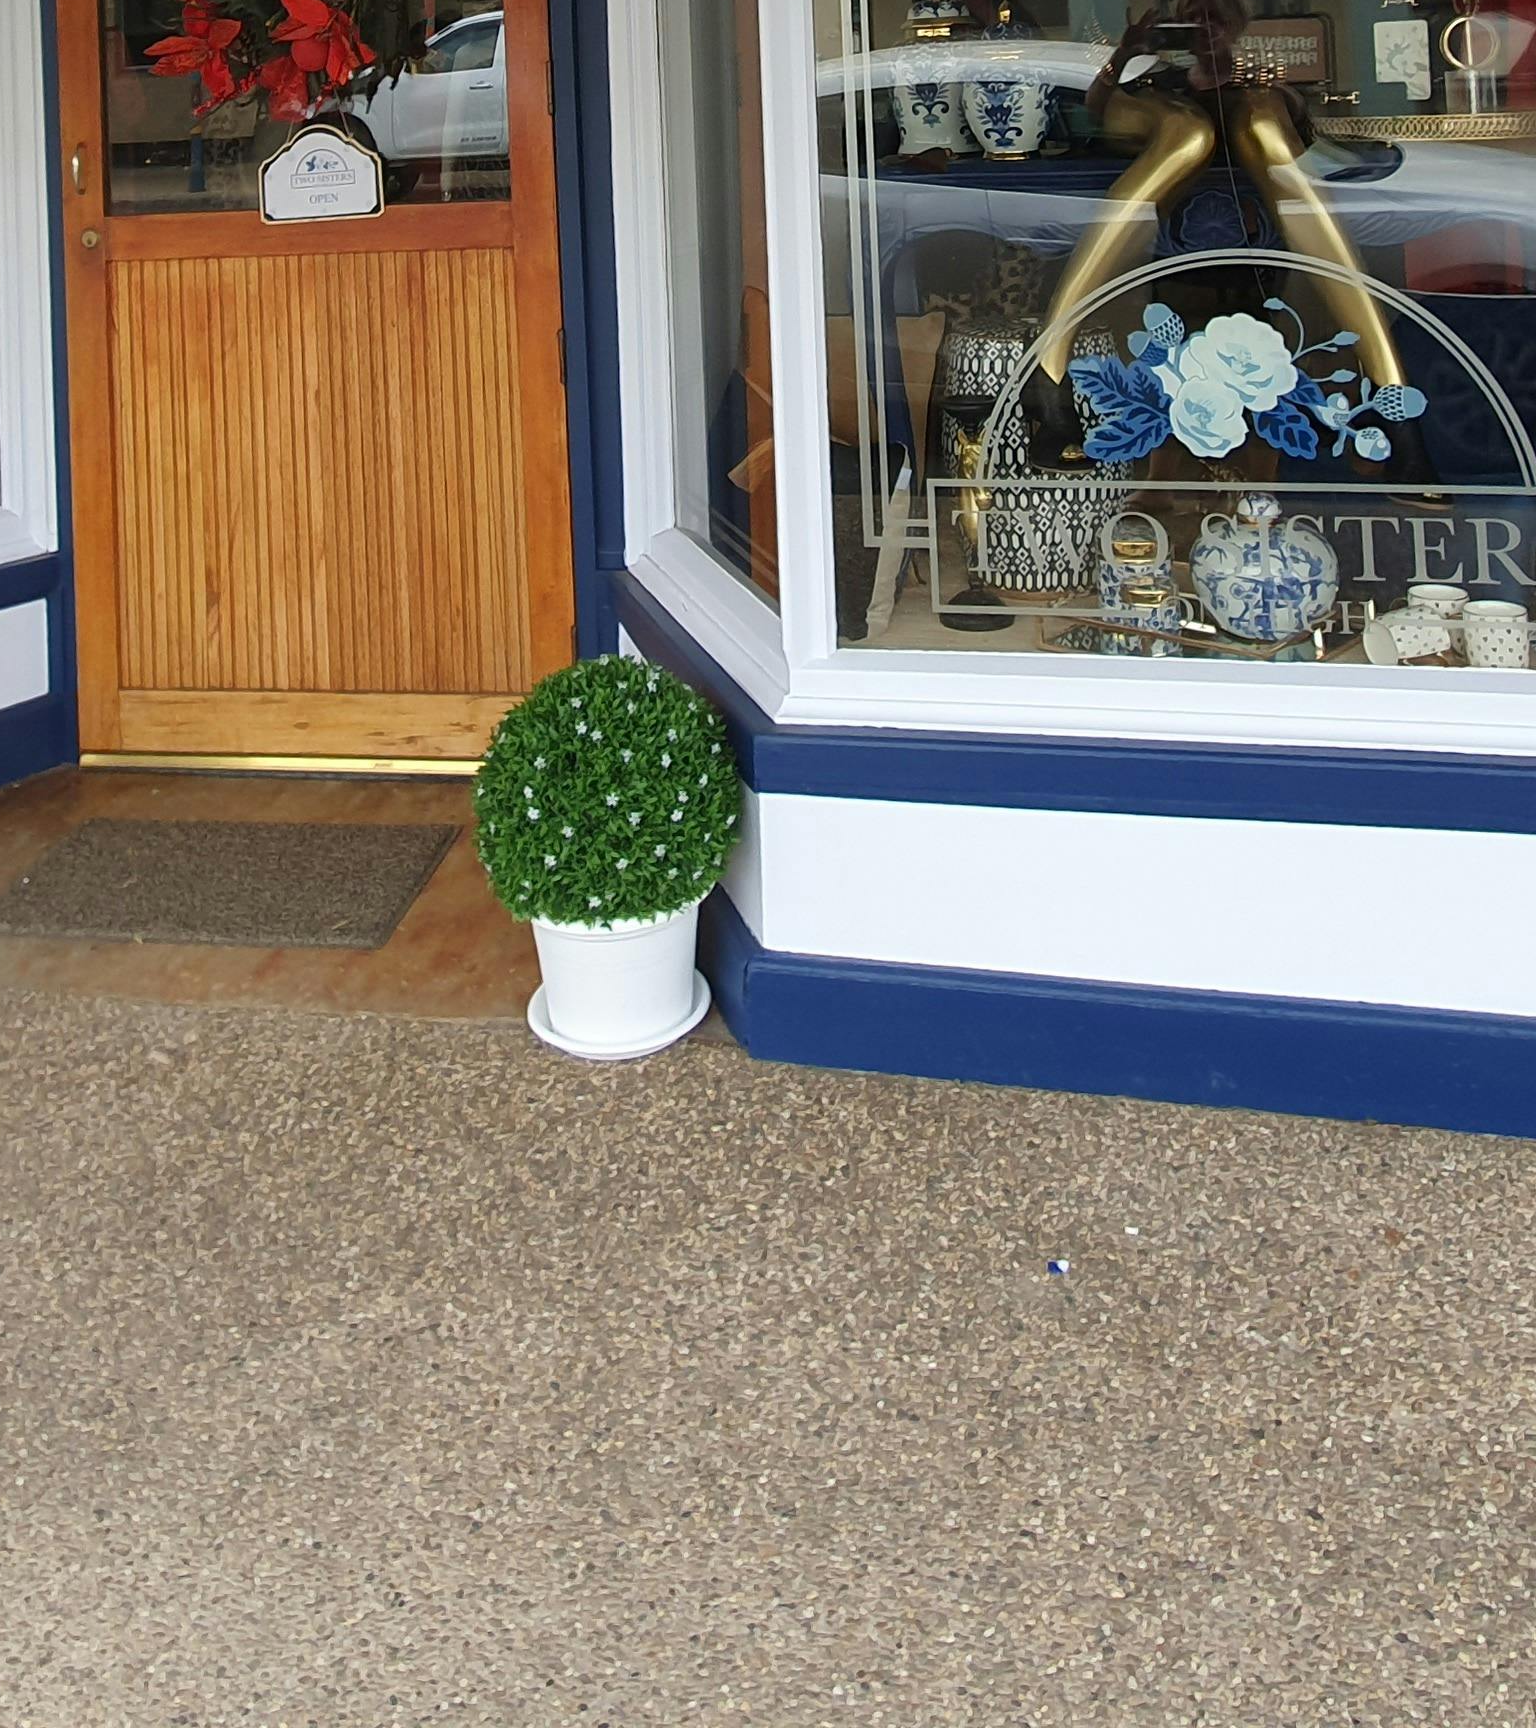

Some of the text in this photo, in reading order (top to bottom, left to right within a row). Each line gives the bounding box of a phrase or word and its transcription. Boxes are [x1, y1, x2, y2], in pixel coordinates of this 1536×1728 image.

[295, 173, 353, 185] TWO SISTERS
[309, 193, 339, 205] OPEN
[950, 509, 1169, 579] TWO
